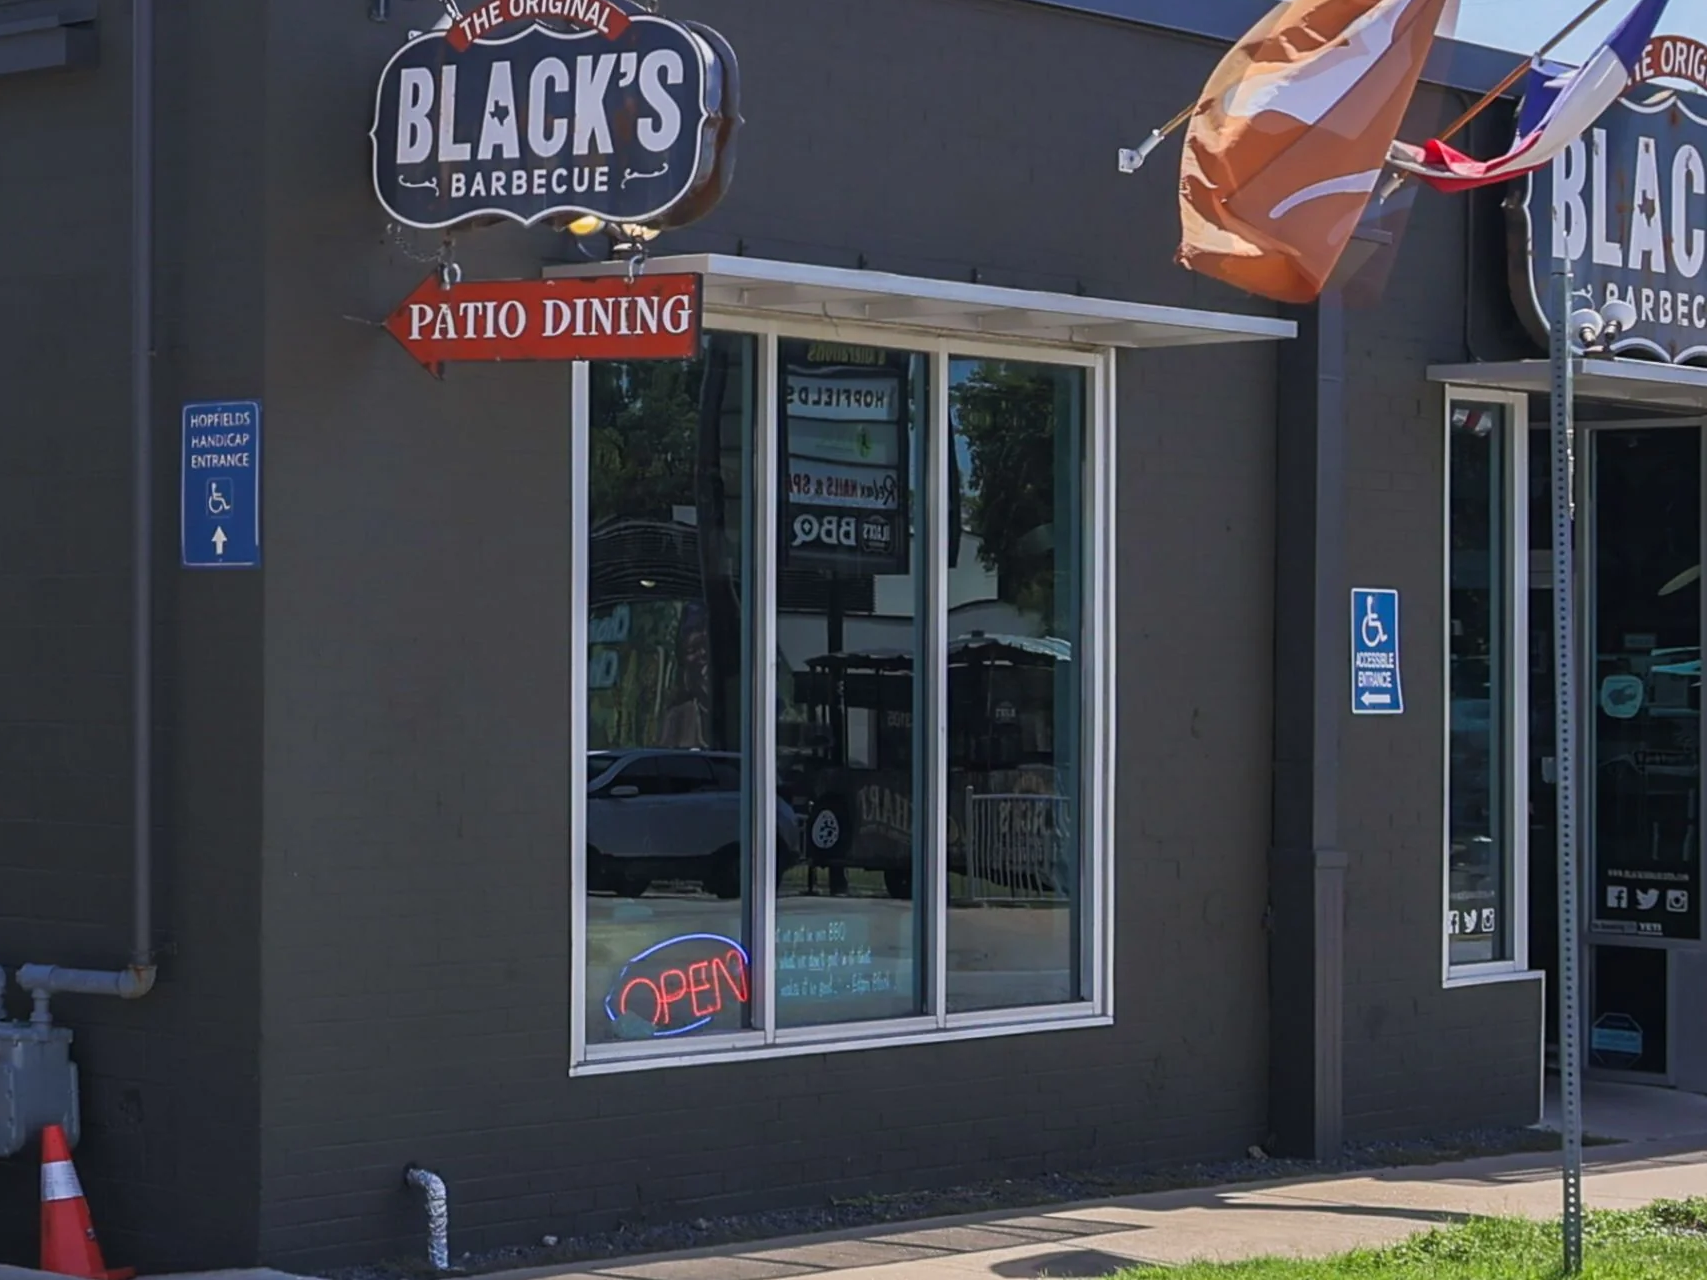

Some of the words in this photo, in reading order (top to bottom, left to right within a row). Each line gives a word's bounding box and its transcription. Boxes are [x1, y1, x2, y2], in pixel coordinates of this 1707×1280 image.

[460, 1, 503, 43] THE
[396, 49, 684, 164] BLACK'S
[450, 165, 610, 198] BARBECUE
[408, 300, 527, 340] PATIO
[542, 294, 692, 338] DINING
[190, 412, 250, 428] HOPFIELDS
[191, 433, 250, 448] HANDICAP
[191, 453, 250, 468] ENTRANCE
[1356, 652, 1394, 668] ACCESSIBLE
[620, 949, 747, 1024] OPEN
